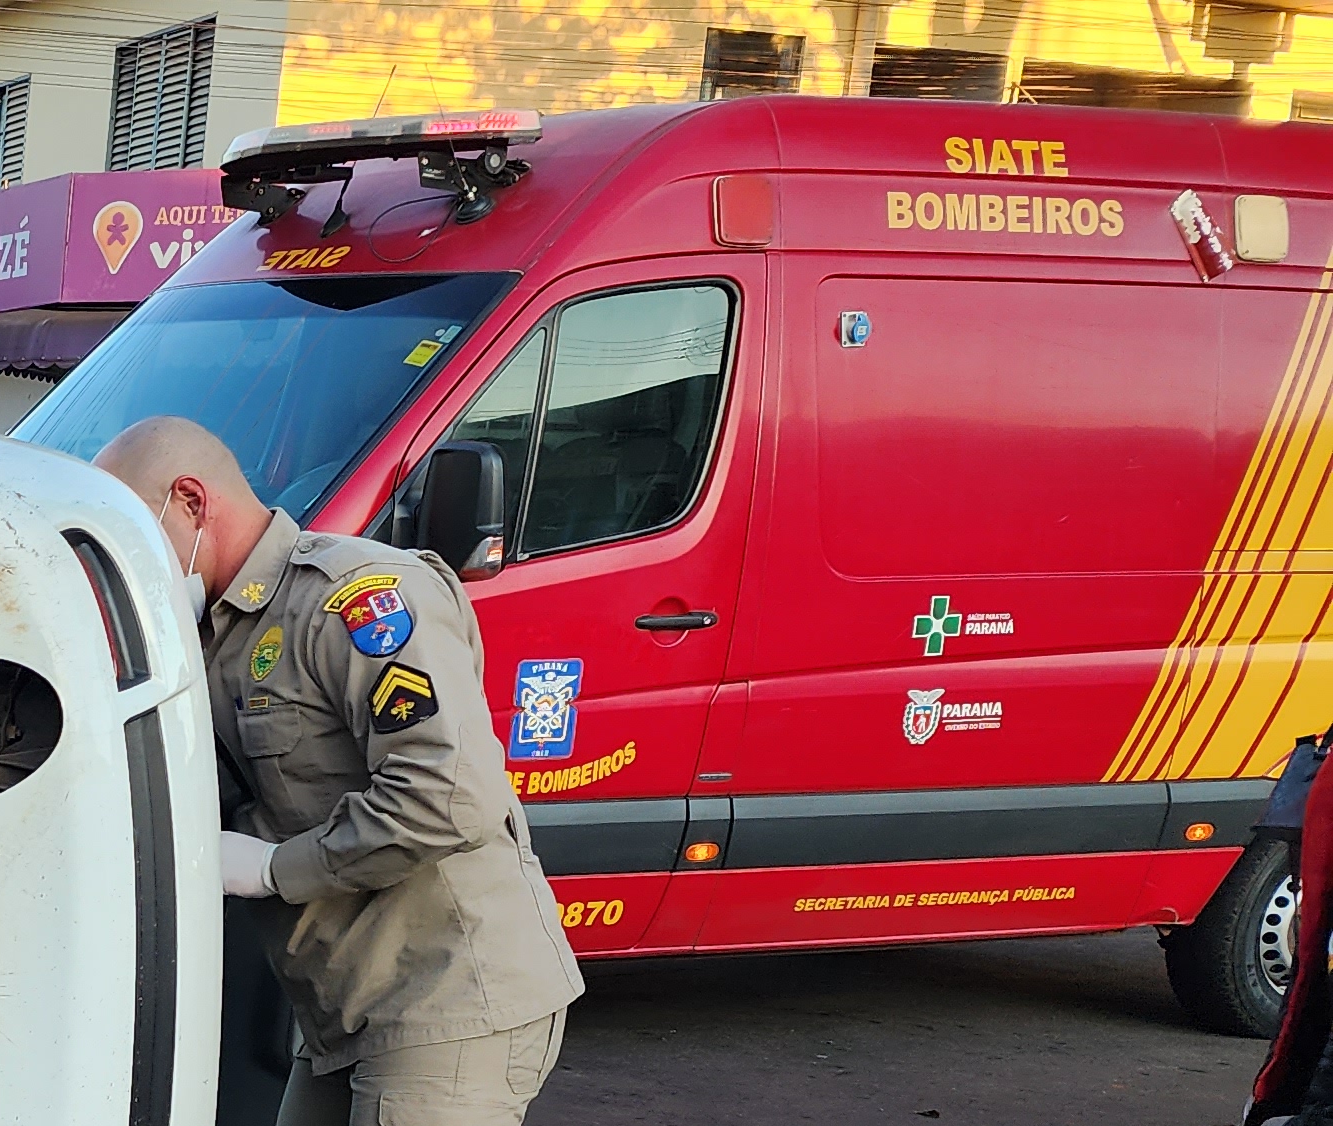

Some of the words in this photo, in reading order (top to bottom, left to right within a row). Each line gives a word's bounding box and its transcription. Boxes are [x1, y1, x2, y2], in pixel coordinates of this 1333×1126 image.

[944, 136, 1069, 178] SIATE
[153, 205, 208, 227] AQUI
[886, 190, 1125, 238] BOMBEIROS
[964, 618, 1014, 635] PARANÁ
[526, 741, 637, 795] BOMBEIROS
[794, 895, 890, 912] SECRETARIA
[893, 893, 917, 908] DE
[917, 889, 1009, 906] SEGURANÇA
[1012, 886, 1076, 902] PÚBLICA
